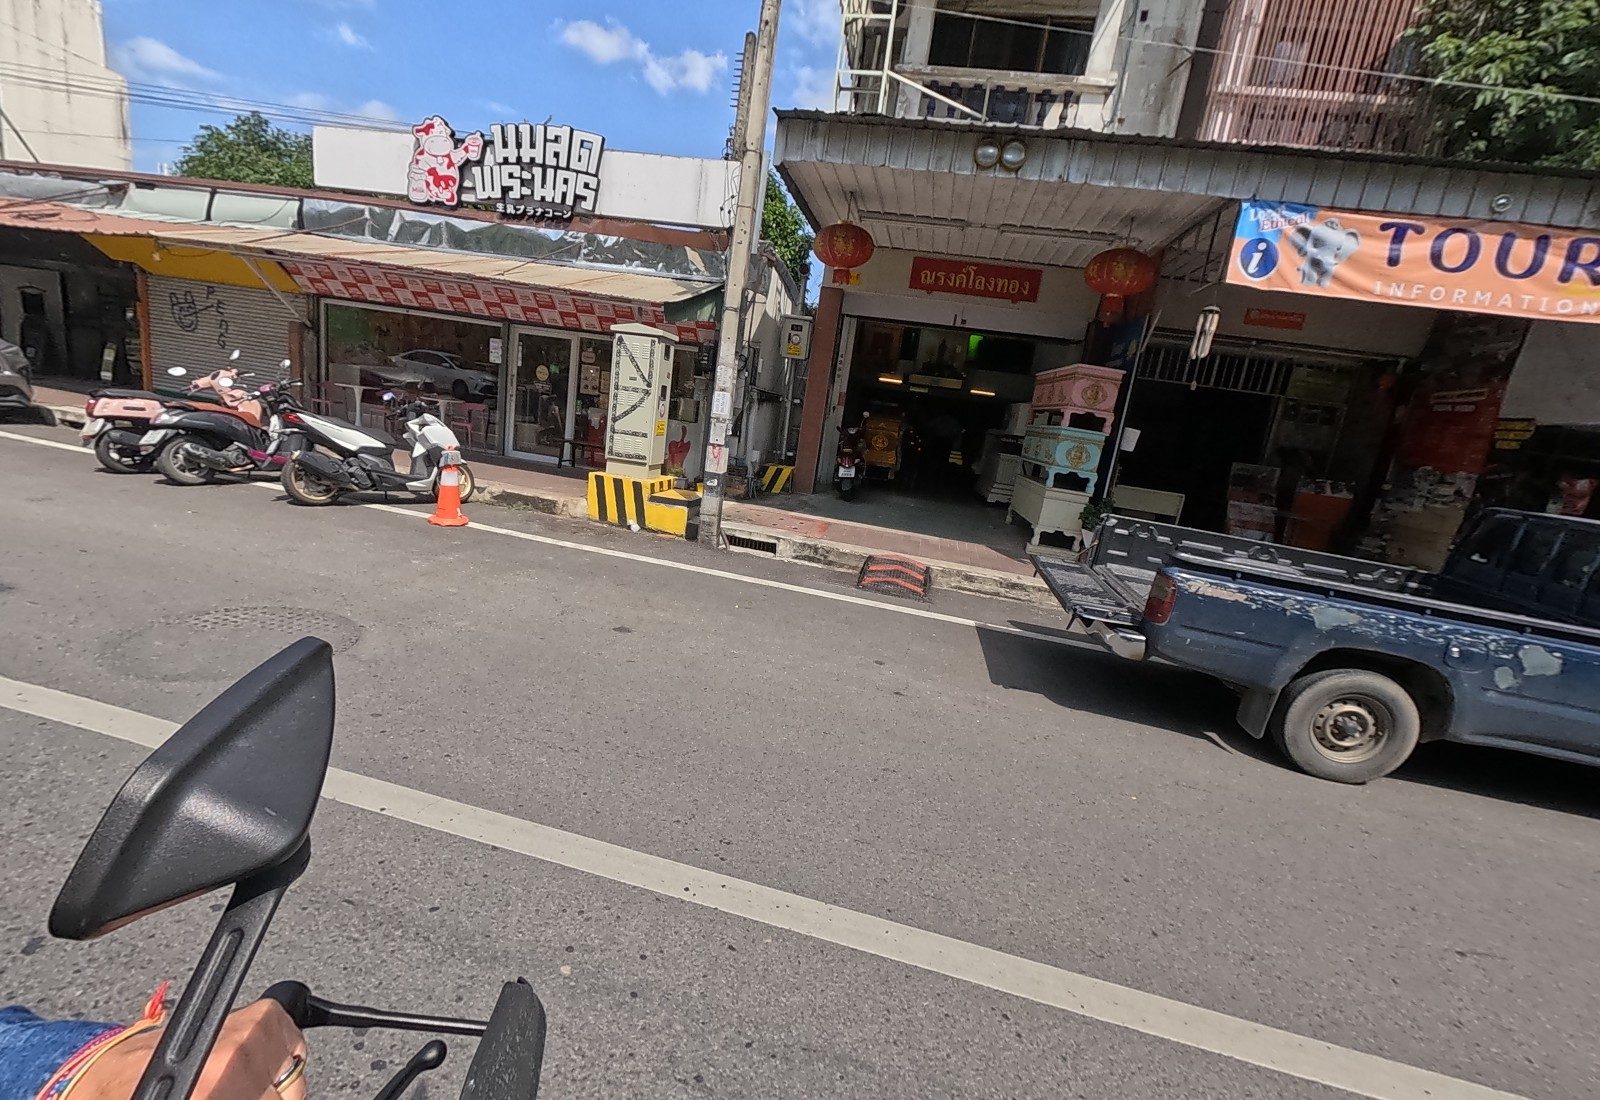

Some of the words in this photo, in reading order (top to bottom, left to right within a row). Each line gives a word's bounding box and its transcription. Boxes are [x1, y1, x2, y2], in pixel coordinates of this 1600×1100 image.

[490, 123, 603, 174] นมสด
[472, 164, 600, 211] พระนคร
[495, 202, 572, 219] 生乳プラナコーン
[1379, 220, 1600, 286] TOUR
[920, 264, 1031, 296] ณรงค์โลงทอง
[1373, 280, 1600, 315] INFORMATION
